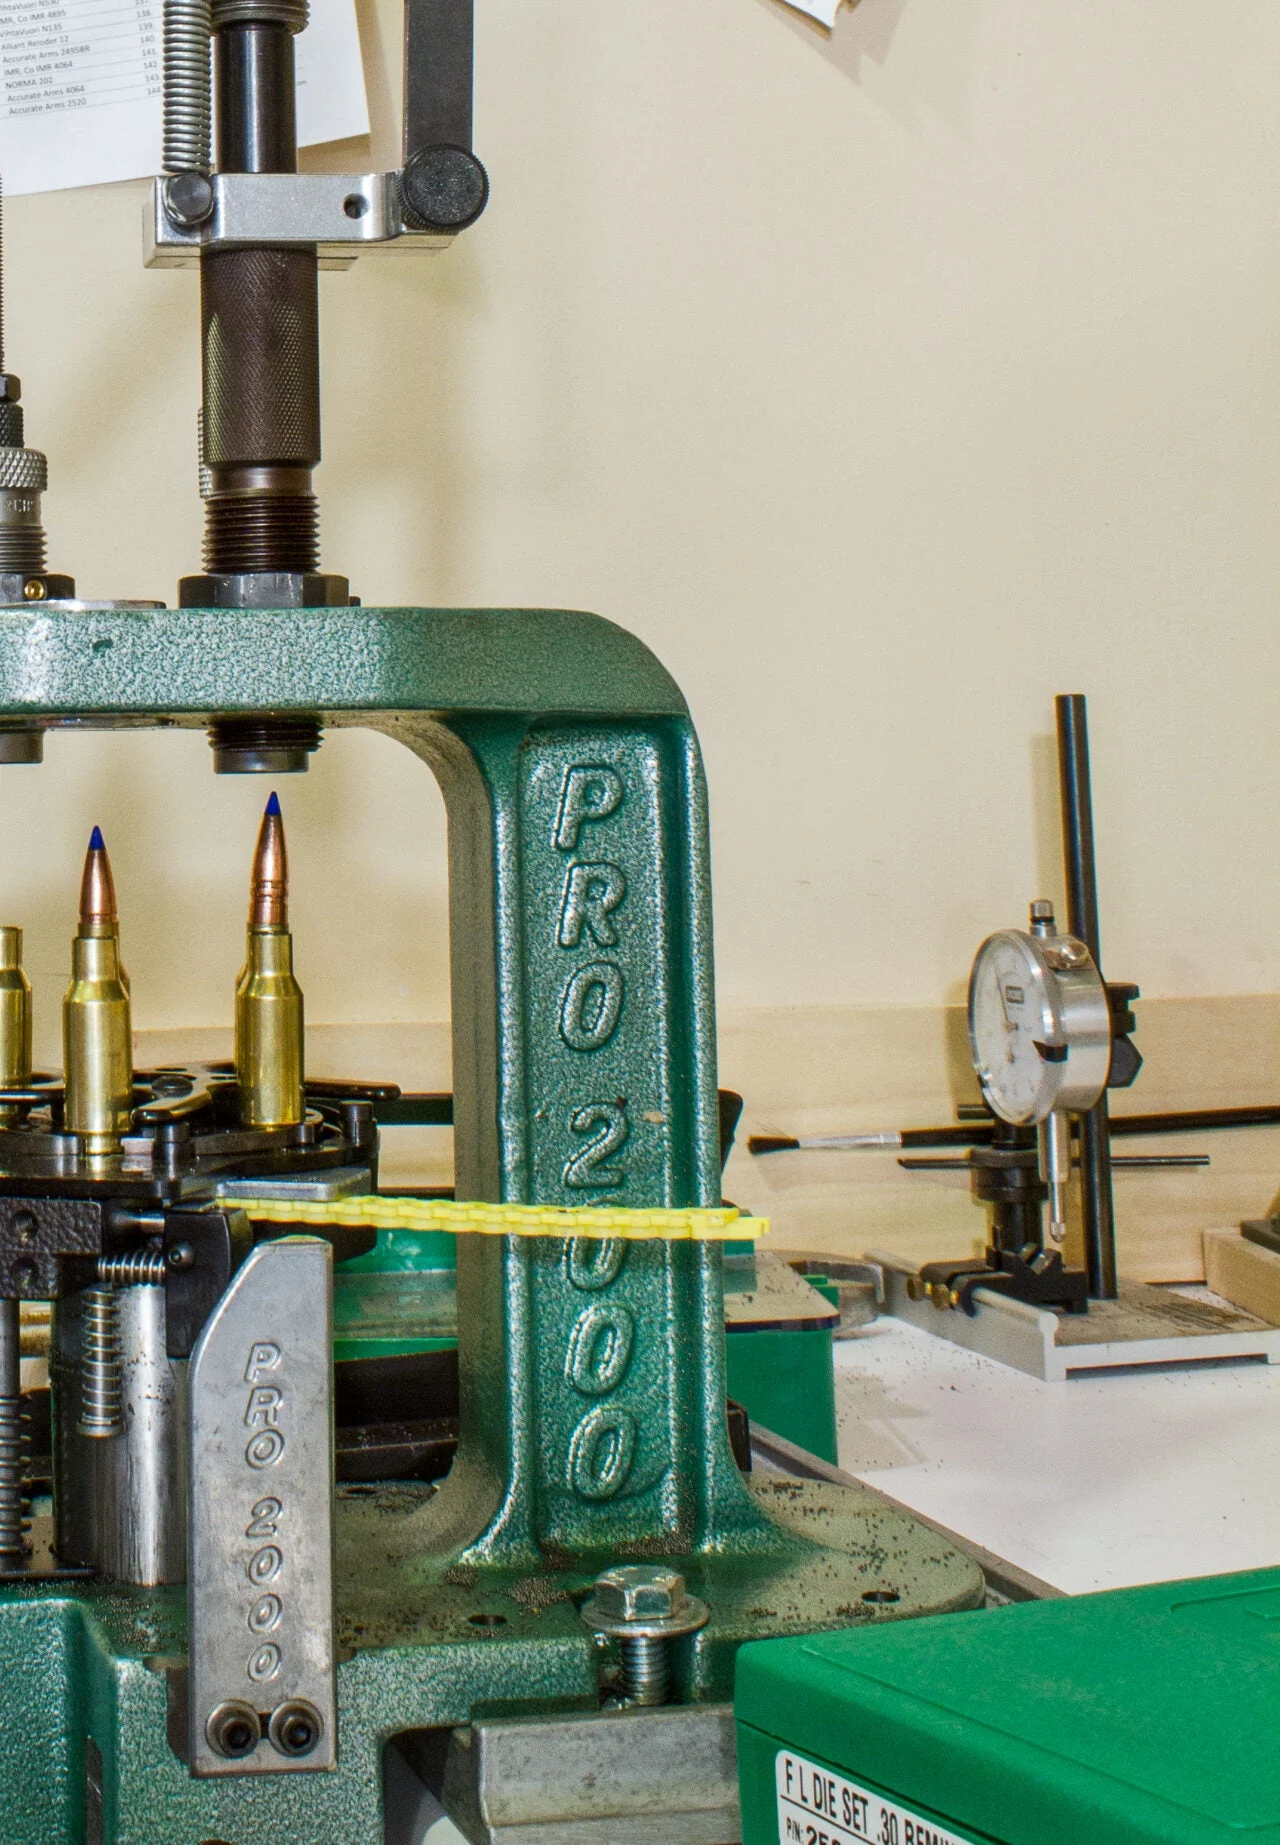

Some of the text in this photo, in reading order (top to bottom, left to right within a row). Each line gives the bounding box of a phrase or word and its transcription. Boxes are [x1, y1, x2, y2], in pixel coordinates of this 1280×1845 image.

[17, 15, 28, 23] Co
[30, 12, 46, 22] IMR
[47, 10, 67, 19] 4895
[0, 27, 41, 38] VihtaVuori
[42, 23, 62, 32] N135
[1, 42, 25, 51] Alliant
[27, 38, 58, 48] Reloder
[59, 35, 69, 43] 12
[2, 54, 37, 64] Accurate
[38, 50, 59, 60] Arms
[23, 66, 34, 74] Co
[36, 63, 53, 73] IMR
[54, 61, 73, 70] 4064
[5, 79, 37, 90] NORMA
[39, 77, 53, 86] 202
[7, 92, 42, 103] Accurate
[43, 88, 64, 98] Arms
[65, 85, 85, 94] 4064
[9, 105, 43, 116] Accurate
[45, 101, 65, 111] Arms
[67, 98, 87, 107] 2520
[552, 765, 638, 1501] PRO 2000
[244, 1341, 286, 1684] PRO 2000
[785, 1757, 793, 1794] F
[799, 1764, 808, 1803] L
[813, 1771, 837, 1819] DIE
[841, 1786, 869, 1835] SET
[877, 1806, 899, 1845] .30
